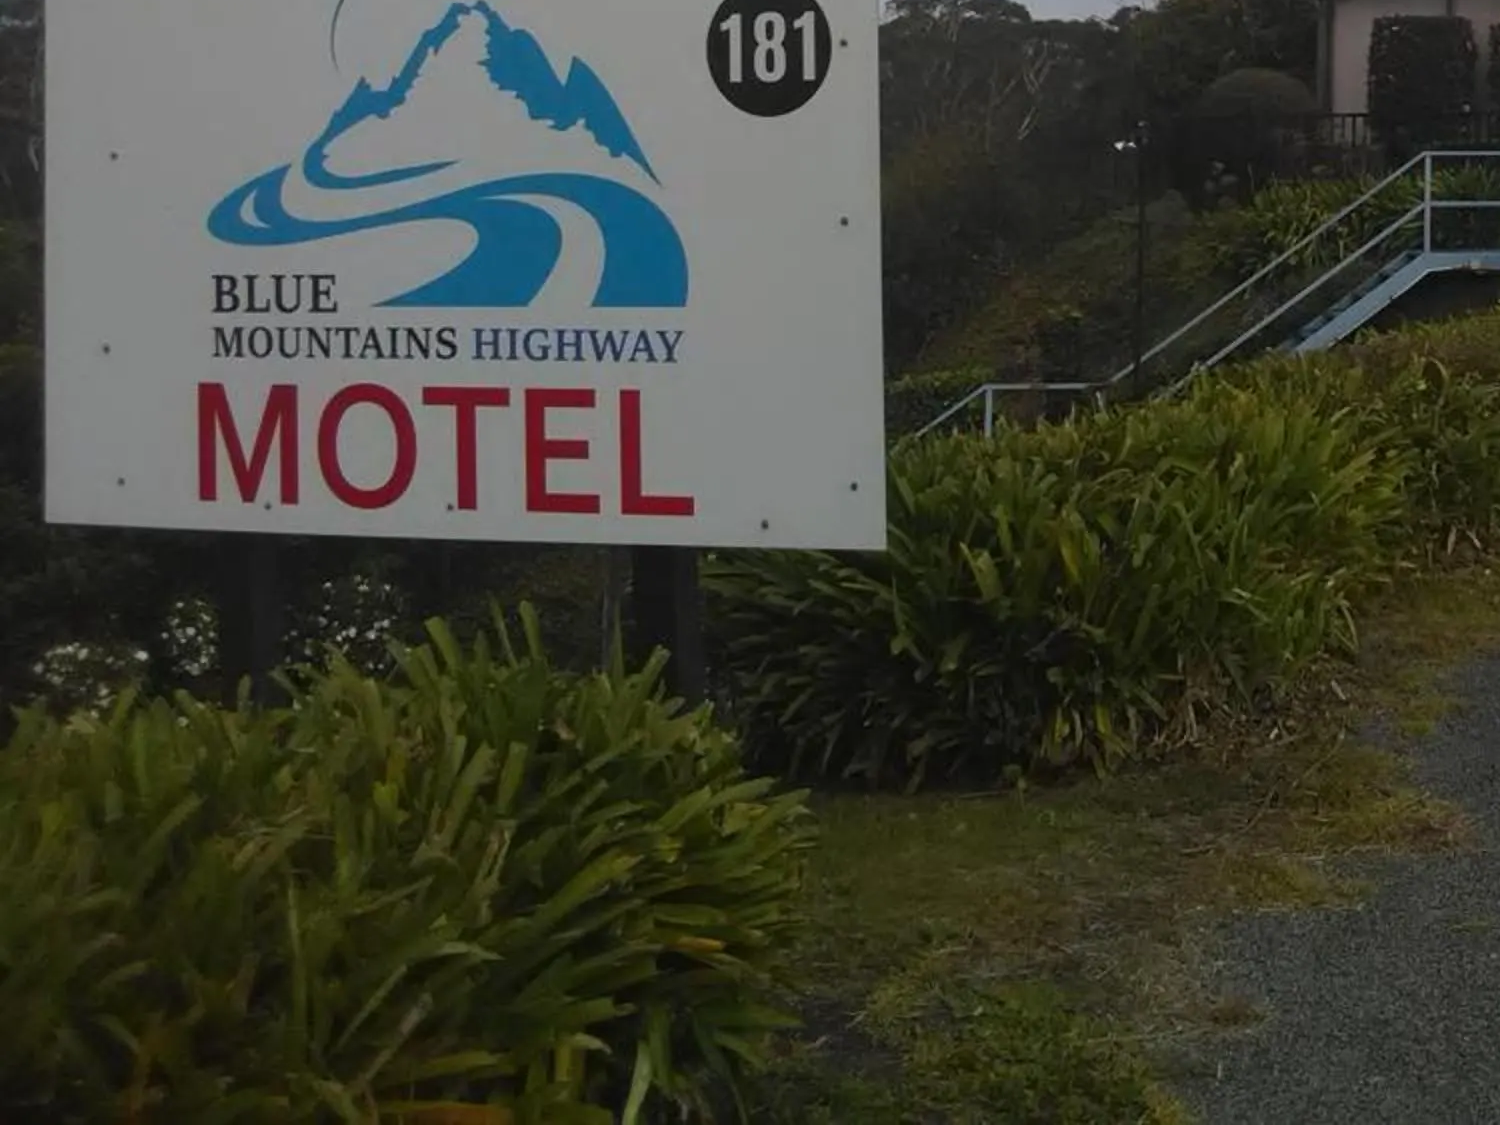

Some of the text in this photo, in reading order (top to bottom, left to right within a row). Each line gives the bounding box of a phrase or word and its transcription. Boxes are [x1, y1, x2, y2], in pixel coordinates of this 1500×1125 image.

[719, 10, 816, 84] 181
[211, 274, 338, 313] BLUE
[212, 326, 684, 363] MOUNTAINS HIGHWAY
[198, 382, 695, 516] MOTEL
